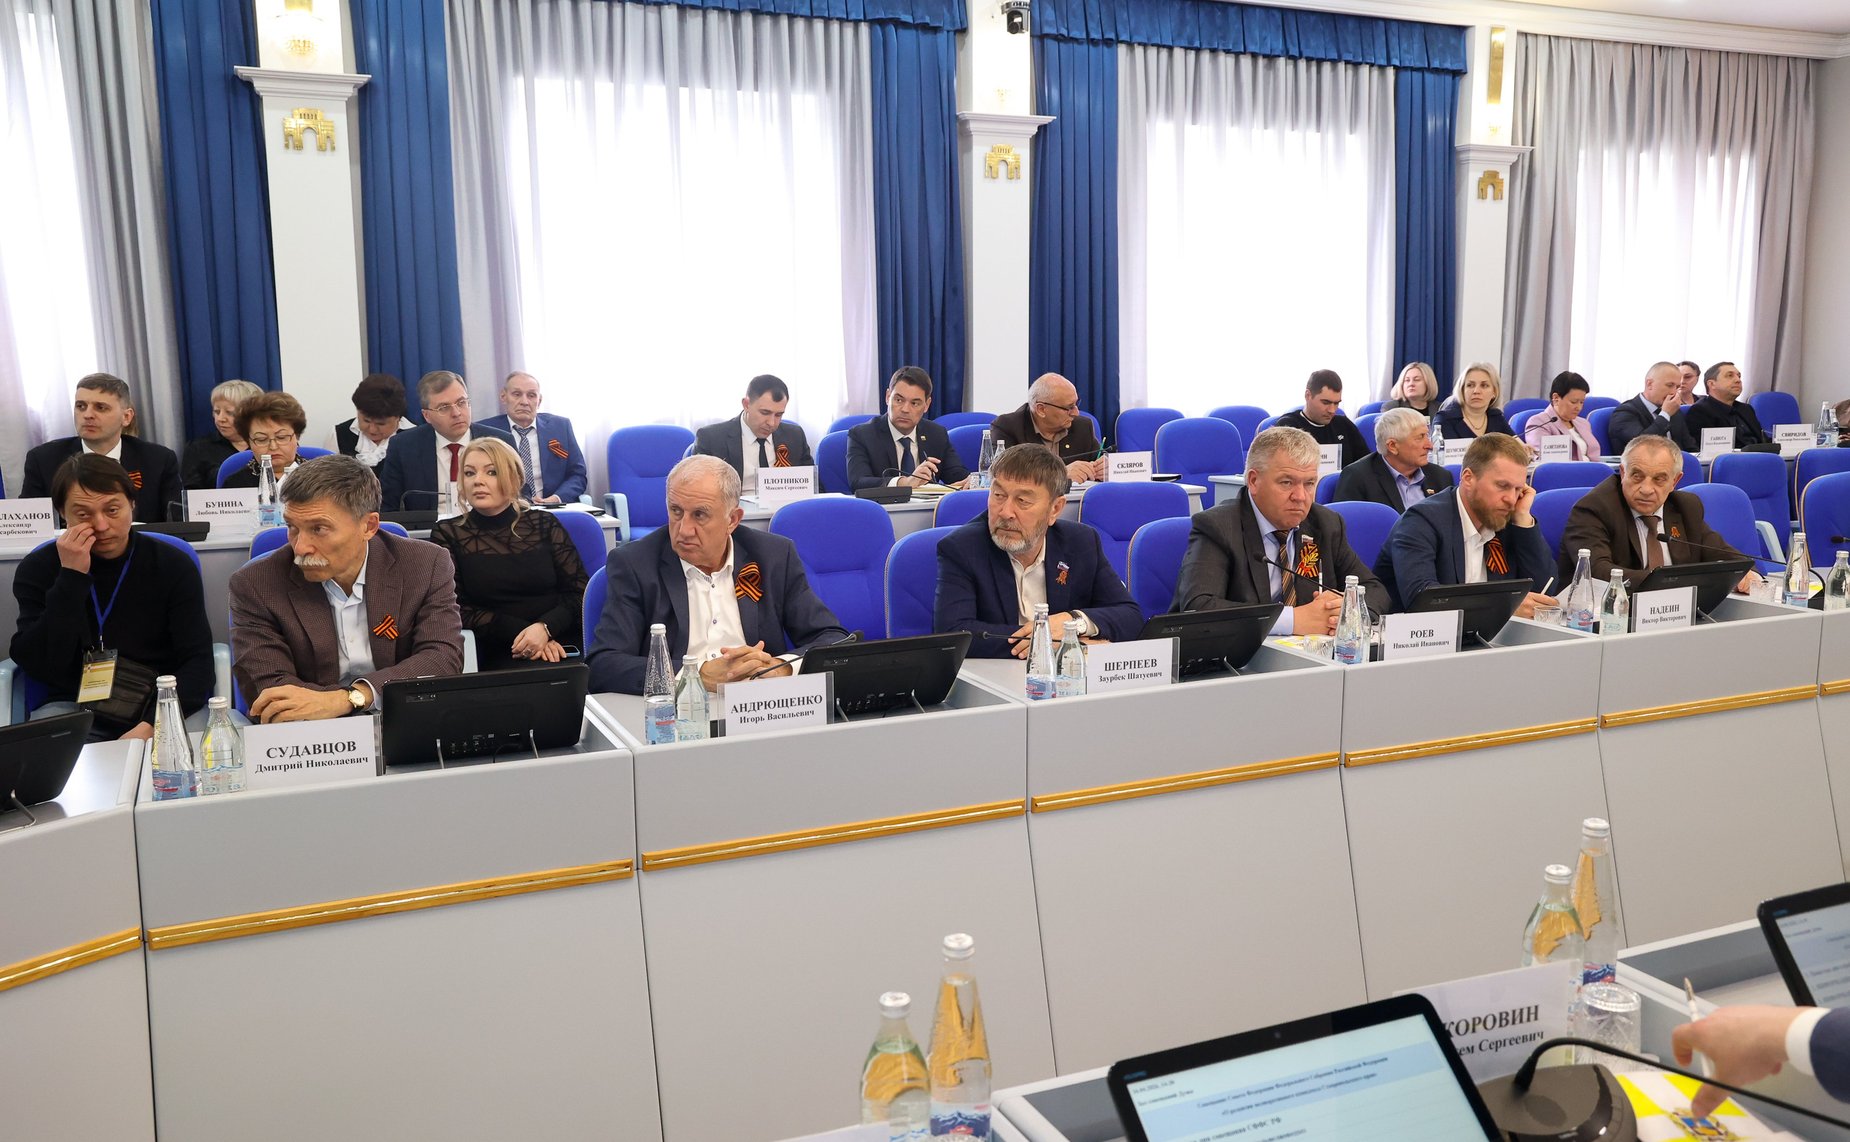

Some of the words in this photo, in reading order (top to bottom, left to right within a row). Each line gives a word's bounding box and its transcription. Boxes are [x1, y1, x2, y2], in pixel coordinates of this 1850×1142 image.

[205, 500, 243, 509] БУНИНА
[1650, 604, 1680, 615] НАДЕИН
[1410, 629, 1434, 639] РОЕВ
[1393, 642, 1420, 650] Николай
[1420, 640, 1450, 648] Иванович
[1104, 658, 1158, 672] ШЕРПЕЕВ
[1099, 674, 1126, 684] Заурбек
[1127, 671, 1163, 681] Шатуевич
[731, 694, 823, 714] АНДРЮЩЕНКО
[739, 715, 765, 724] Игорь
[767, 710, 815, 721] Васильевич
[266, 740, 357, 759] СУДАВЦОВ
[254, 760, 303, 774] Дмитрий
[305, 756, 369, 769] Николаевич
[1478, 1031, 1545, 1053] Сергеевич
